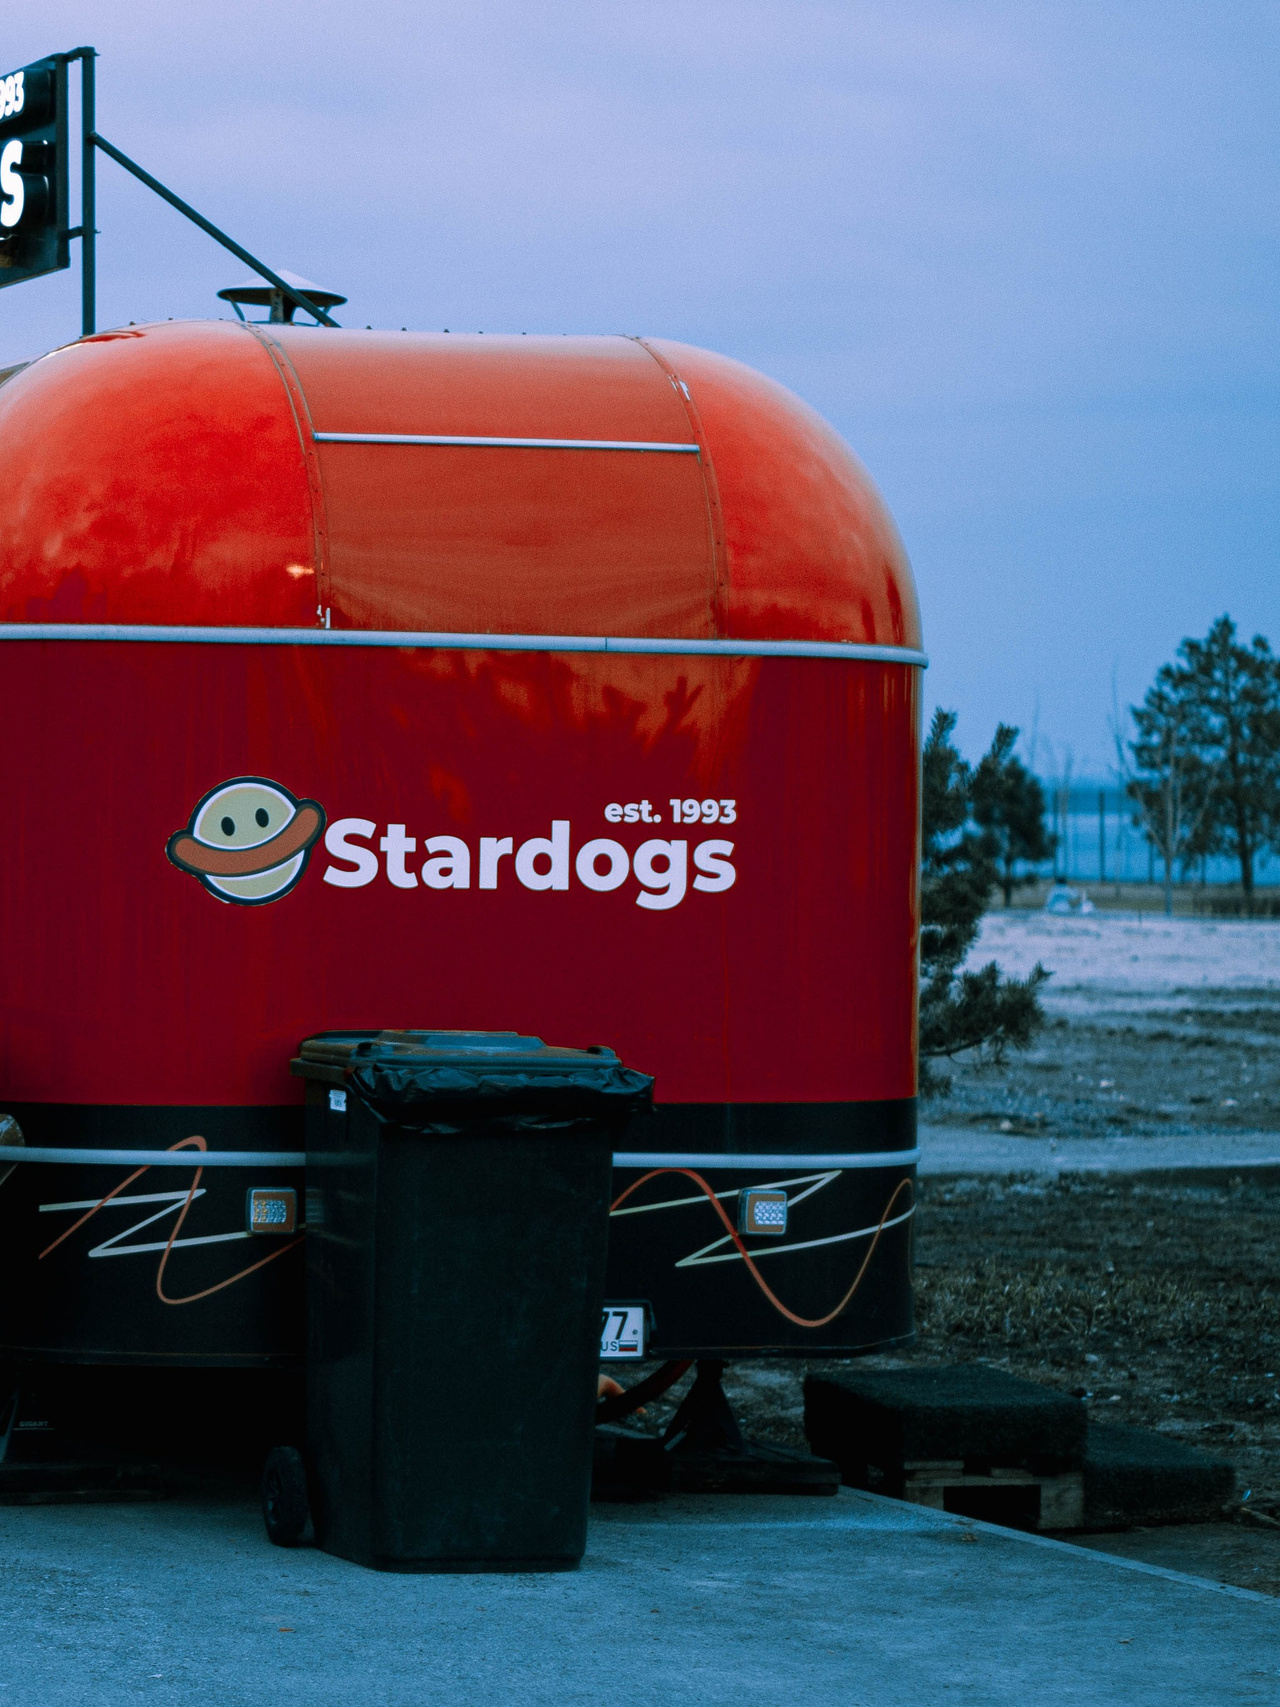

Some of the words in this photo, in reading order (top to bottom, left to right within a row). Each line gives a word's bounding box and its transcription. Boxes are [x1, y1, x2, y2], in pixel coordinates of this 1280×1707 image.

[604, 800, 662, 825] est.
[669, 798, 737, 825] 1993
[322, 817, 737, 911] Stardogs
[601, 1341, 618, 1352] US
